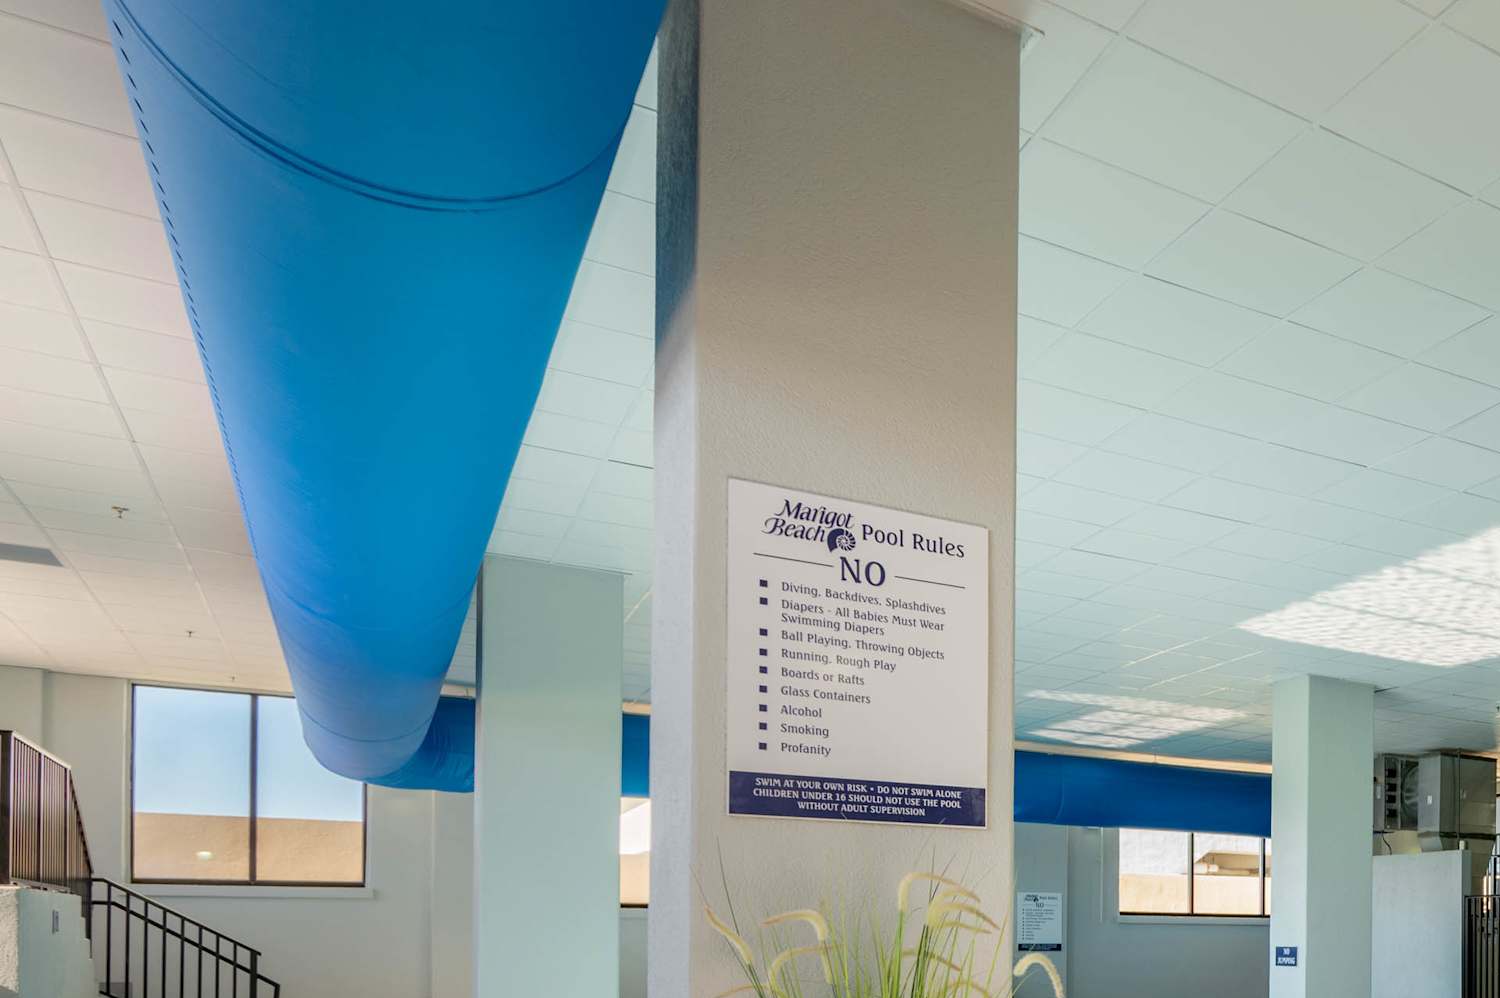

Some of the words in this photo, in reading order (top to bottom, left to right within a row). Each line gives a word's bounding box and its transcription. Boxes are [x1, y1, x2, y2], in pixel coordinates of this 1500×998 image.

[774, 499, 855, 528] Marigot
[761, 517, 825, 542] Beach
[861, 524, 904, 547] Pool
[912, 533, 966, 559] Rules
[839, 556, 886, 587] NO
[781, 599, 824, 614] Diapers
[835, 607, 850, 618] All
[853, 609, 889, 623] Babies
[892, 615, 917, 627] Must
[919, 619, 945, 631] Wear
[885, 597, 946, 615] Splashdives
[781, 612, 840, 632] Swimming
[844, 621, 885, 636] Diapers
[781, 629, 803, 642] Ball
[854, 639, 905, 656] Throwing
[907, 646, 945, 660] Objects
[836, 655, 870, 669] Rough
[873, 659, 897, 672] Play
[781, 666, 820, 681] Boards
[822, 673, 834, 682] or
[837, 673, 865, 686] Rafts
[780, 685, 810, 697] Glass
[813, 688, 871, 704] Containers
[780, 704, 822, 718] Alcohol
[780, 723, 830, 739] Smoking
[780, 742, 832, 757] Profanity
[753, 787, 799, 799] CHILDREN
[801, 791, 833, 801] UNDER
[835, 793, 847, 802] 16
[848, 793, 883, 804] SHOULD
[885, 796, 902, 805] NOT
[904, 797, 921, 806] USE
[922, 798, 939, 807] THE
[940, 800, 962, 809] POOL
[754, 777, 781, 787] SWIM
[783, 779, 794, 788] AT
[796, 780, 821, 789] YOUR
[823, 782, 845, 791] OWN
[846, 783, 868, 793] RISK
[877, 785, 890, 794] DO
[891, 787, 909, 795] NOT
[910, 788, 934, 797] SWIM
[935, 789, 962, 799] ALONE
[797, 801, 839, 811] WITHOUT
[840, 803, 868, 813] ADULT
[870, 805, 926, 817] SUPERVISION
